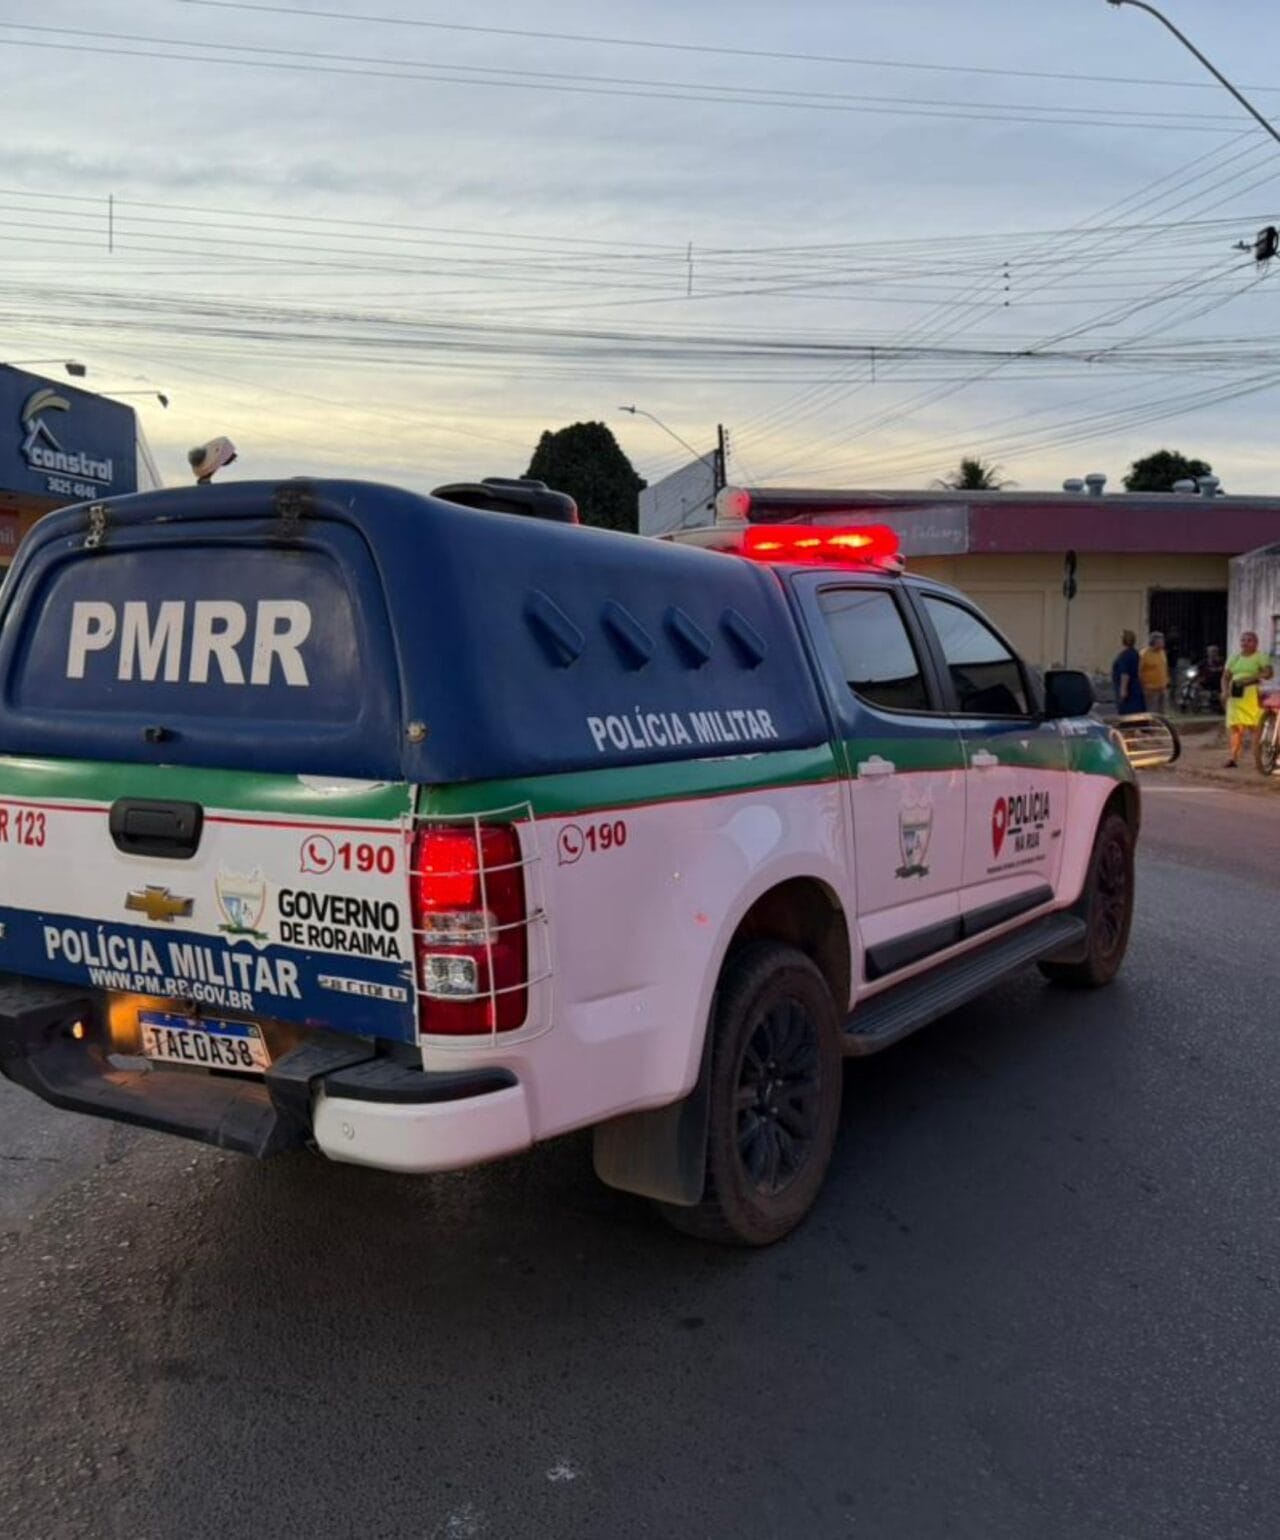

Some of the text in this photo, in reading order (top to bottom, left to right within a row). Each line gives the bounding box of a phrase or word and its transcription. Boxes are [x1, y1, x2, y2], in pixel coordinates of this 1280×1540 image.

[66, 600, 312, 686] PMRR
[586, 705, 779, 751] POLÍCIA MILITAR
[15, 809, 46, 847] 123
[585, 820, 627, 852] 190
[337, 842, 395, 874] 190
[278, 888, 399, 933] GOVERNO
[280, 920, 401, 960] DE RORAIMA
[43, 925, 163, 975] POLÍCIA
[168, 942, 302, 999] MILITAR
